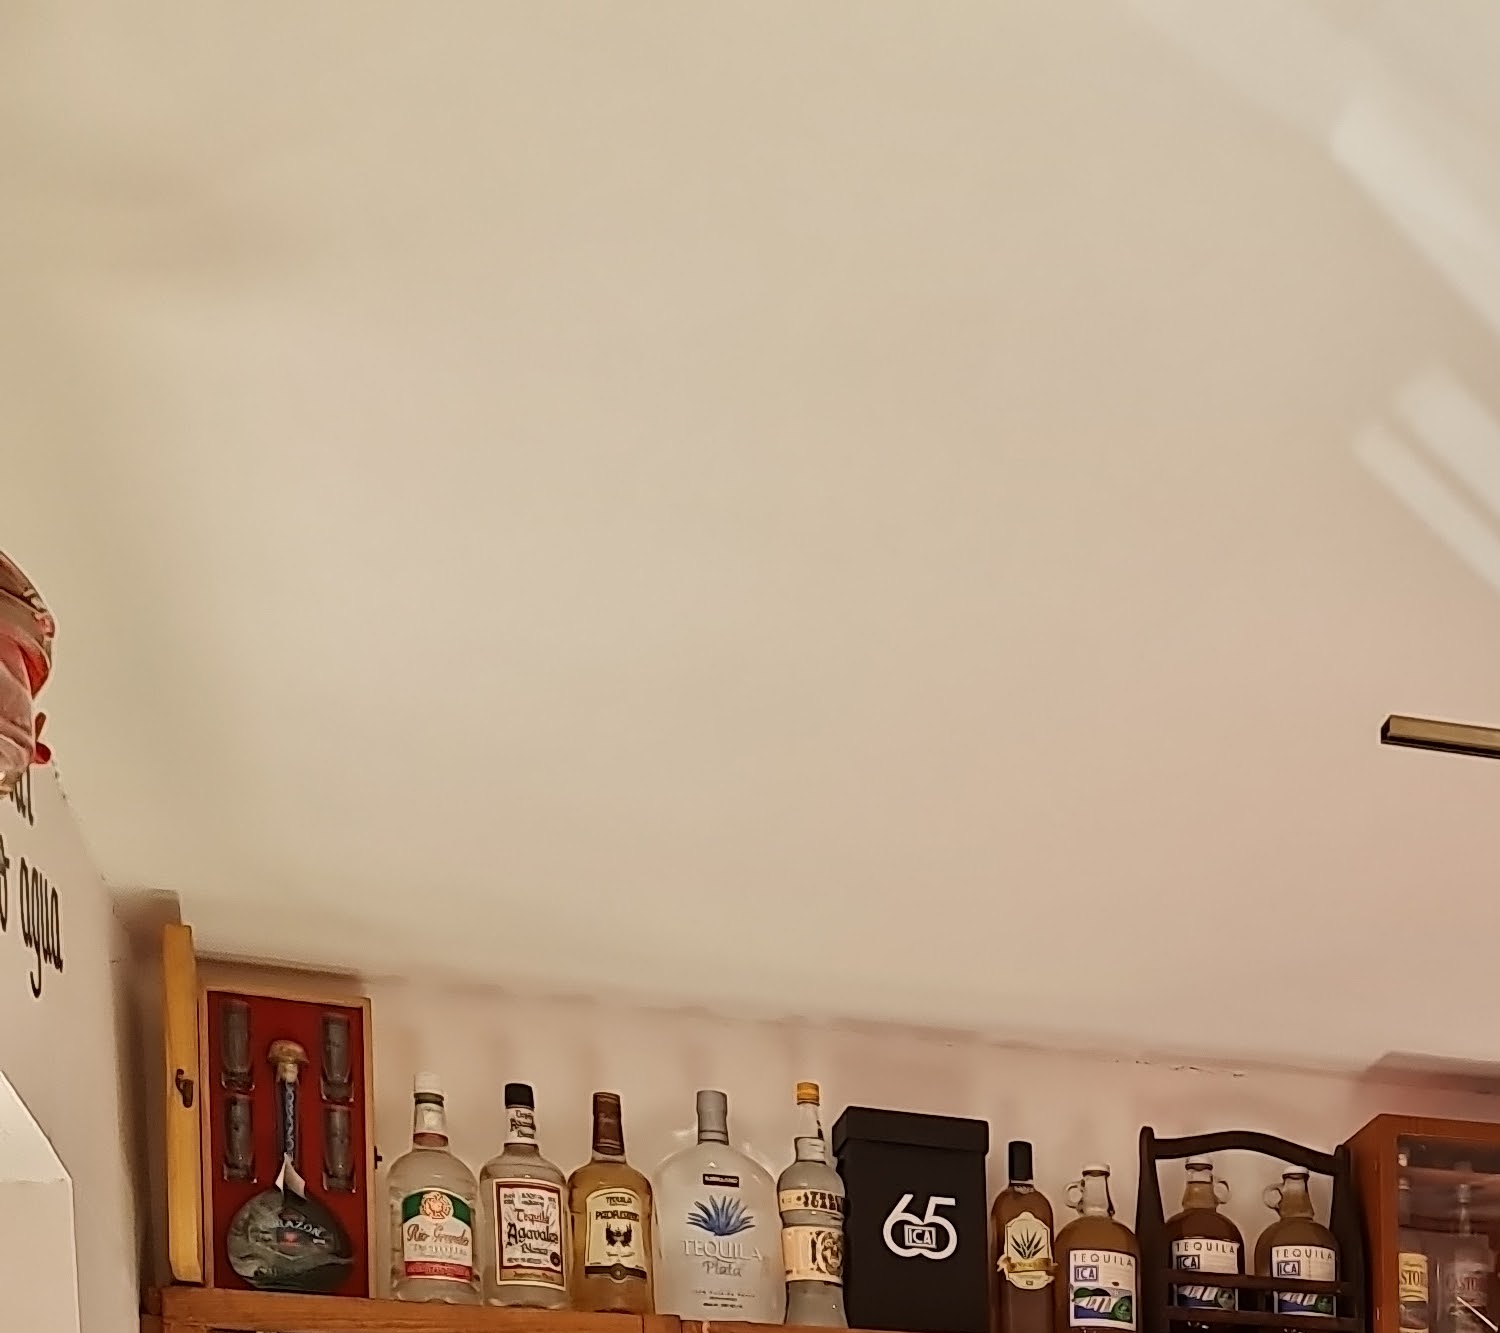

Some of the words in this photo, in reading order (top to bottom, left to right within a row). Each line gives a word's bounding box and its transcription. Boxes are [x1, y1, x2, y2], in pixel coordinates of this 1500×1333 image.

[19, 856, 63, 998] agua
[515, 1208, 550, 1225] Tequila
[882, 1193, 958, 1260] 65
[908, 1228, 933, 1245] ICA
[683, 1239, 764, 1263] TEQUILA
[1175, 1241, 1236, 1254] TEQUILA
[1275, 1249, 1333, 1260] TEQUILA
[1073, 1252, 1134, 1266] TEQUILA
[1180, 1257, 1198, 1269] ICA
[702, 1260, 742, 1278] Plata
[1075, 1268, 1095, 1281] ICA
[1281, 1263, 1298, 1276] ICA
